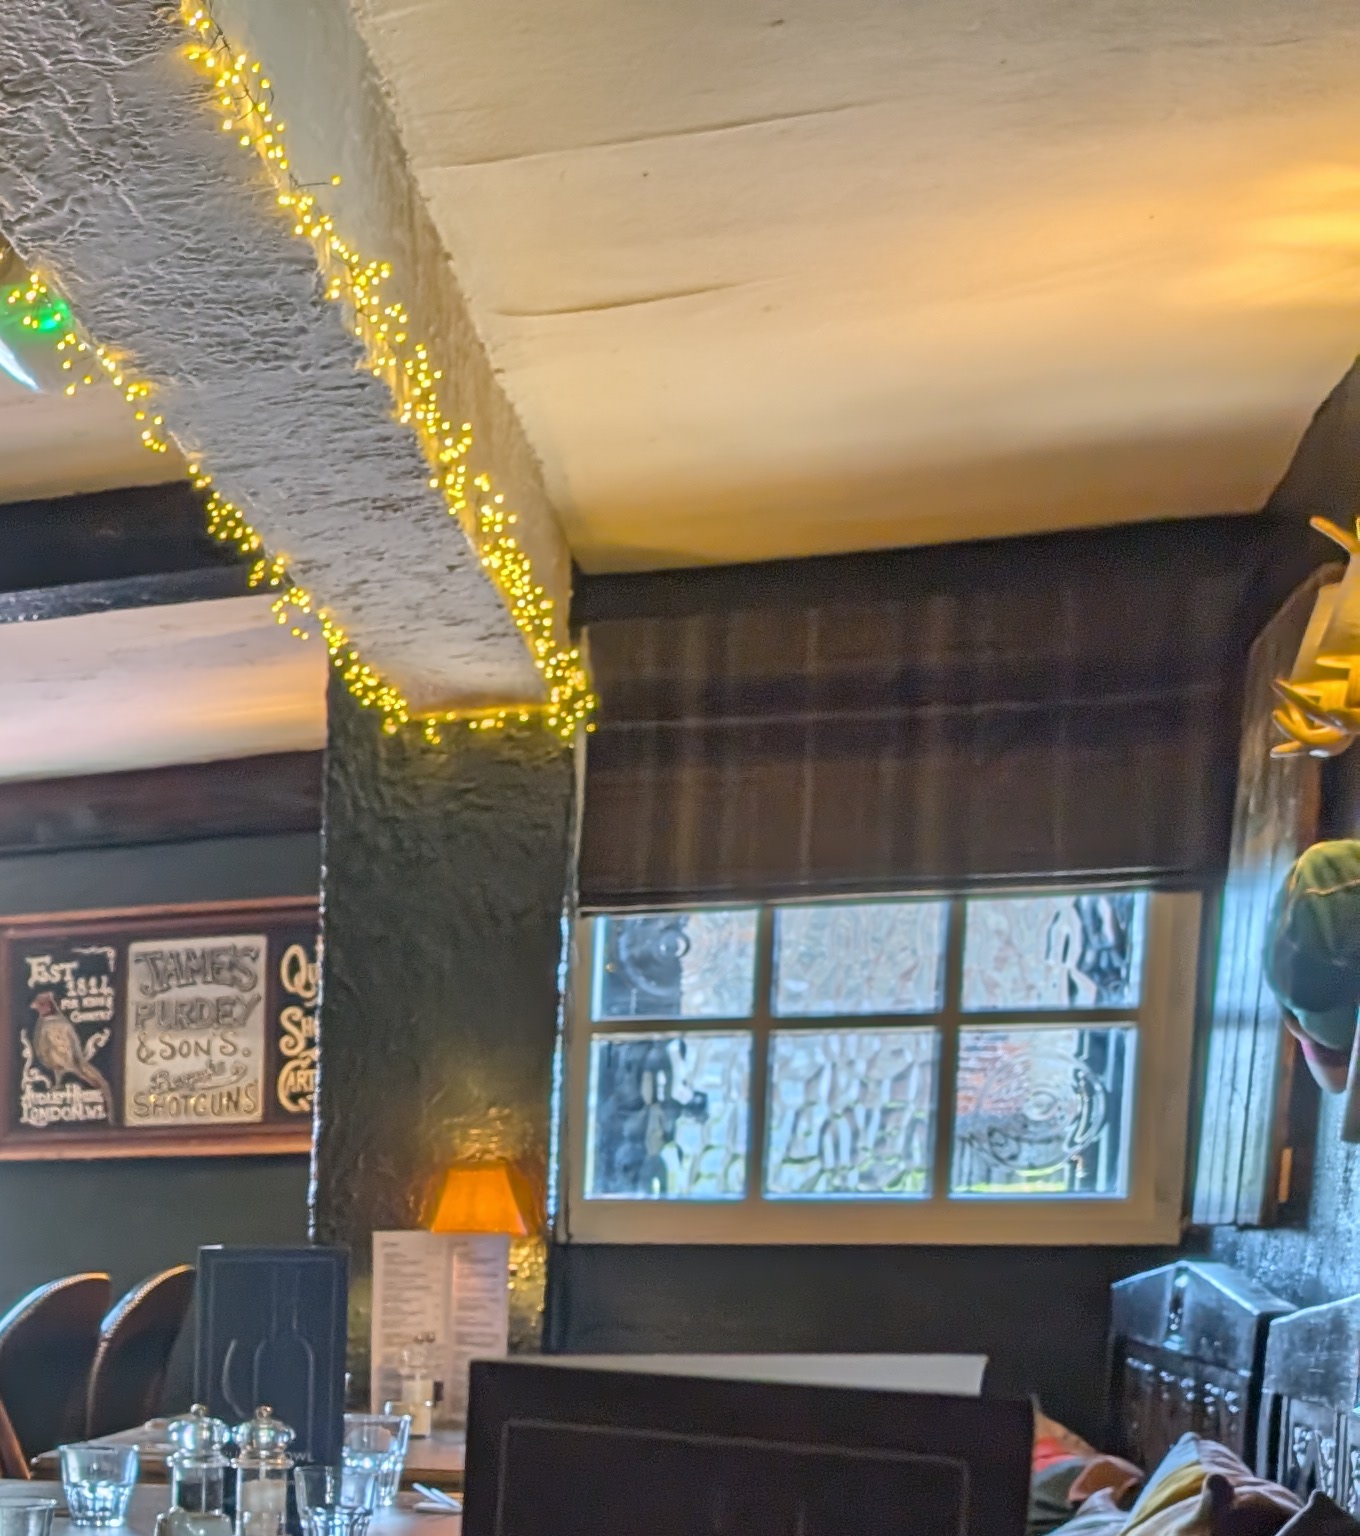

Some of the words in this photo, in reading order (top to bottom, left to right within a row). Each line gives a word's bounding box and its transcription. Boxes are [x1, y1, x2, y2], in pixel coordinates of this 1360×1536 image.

[134, 994, 261, 1030] PURDEY
[133, 1079, 258, 1118] SHOTGUNS
[286, 1451, 315, 1463] OWL
